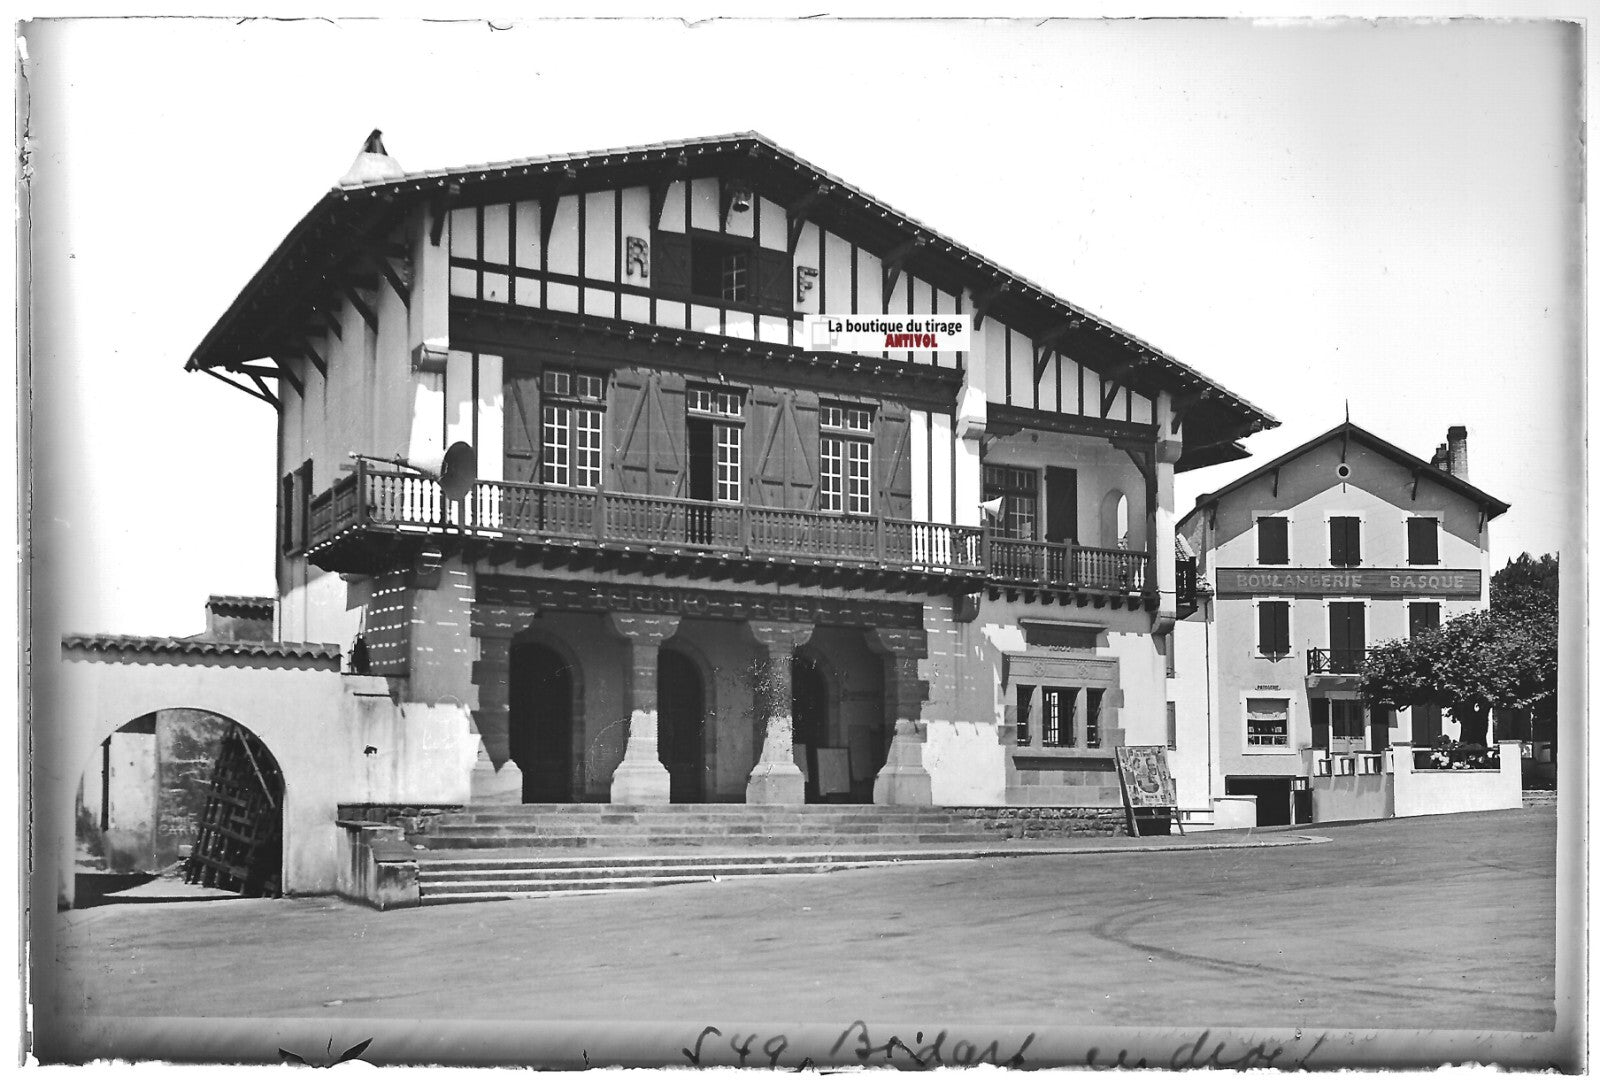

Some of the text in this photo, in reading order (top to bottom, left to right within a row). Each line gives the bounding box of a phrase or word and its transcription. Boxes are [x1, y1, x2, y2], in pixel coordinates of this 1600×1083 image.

[626, 236, 819, 303] R F
[1236, 573, 1465, 590] BOULANGERIE BASQUE
